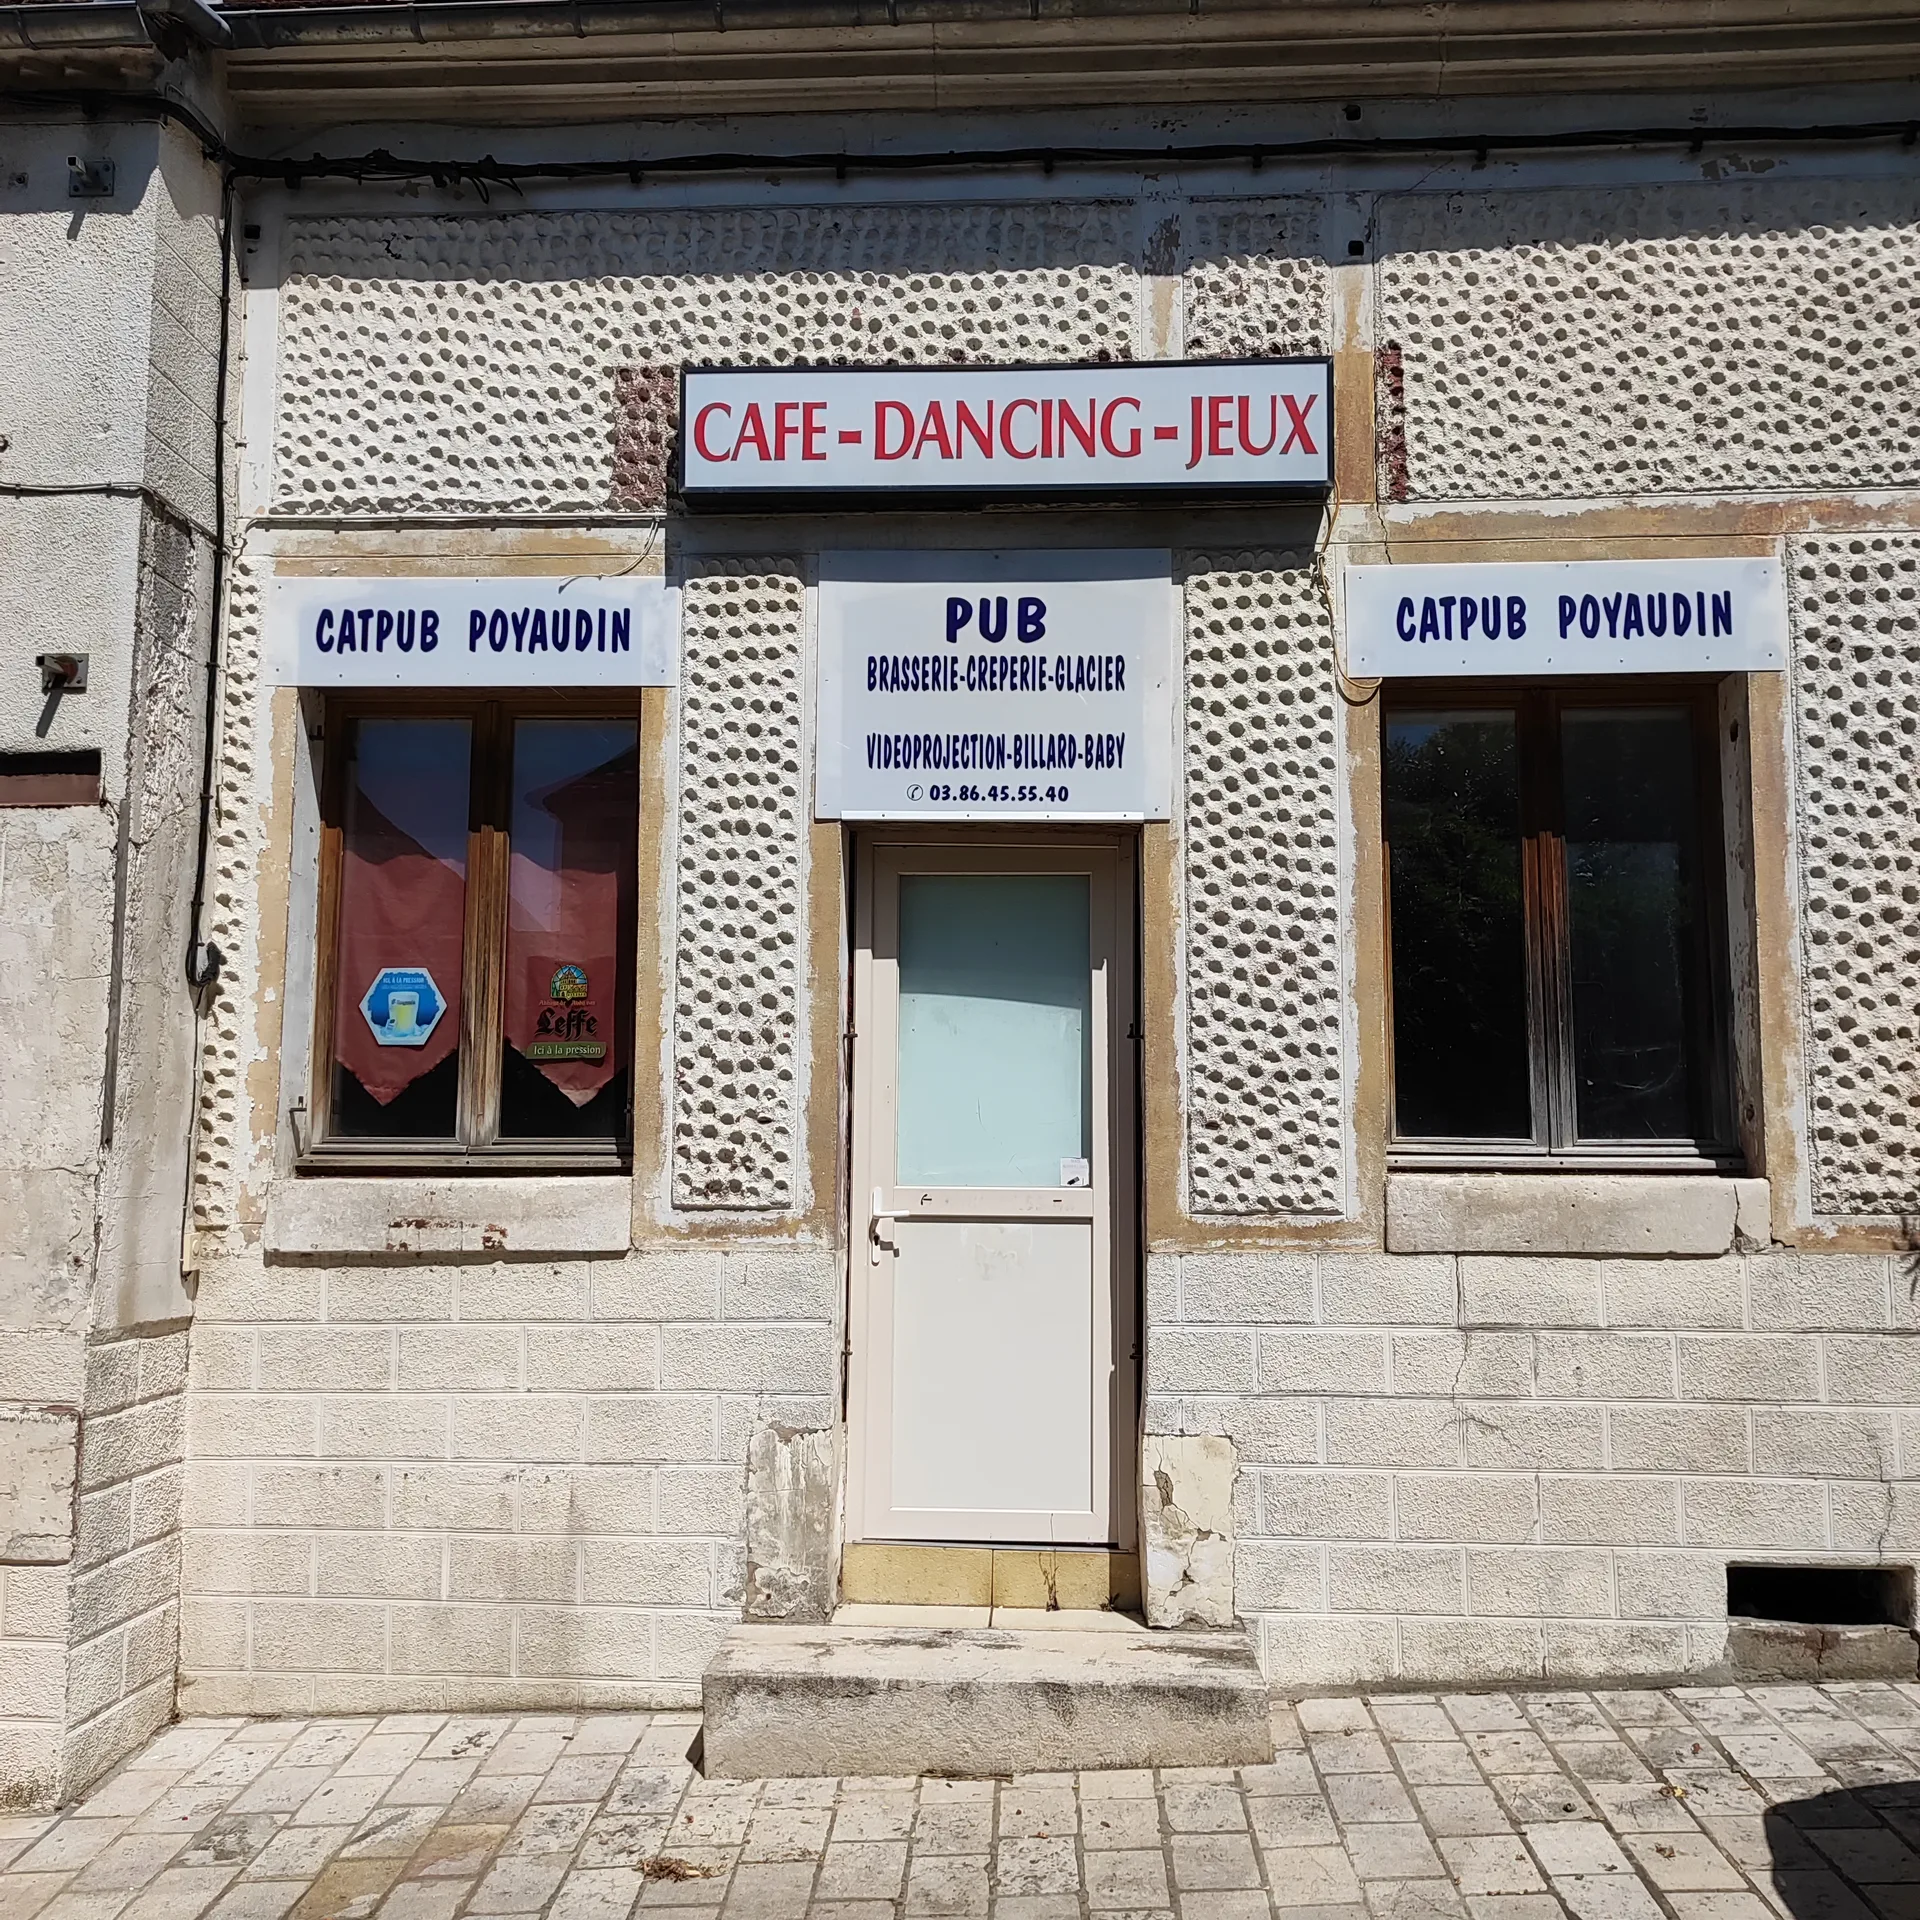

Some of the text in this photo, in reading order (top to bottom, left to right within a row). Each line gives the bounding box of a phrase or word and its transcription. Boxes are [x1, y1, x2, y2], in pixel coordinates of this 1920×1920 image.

[315, 606, 632, 655] CATPUB POYAUDIN
[945, 595, 1048, 645] PUB
[1396, 590, 1734, 644] CATPUB POYAUDIN
[928, 784, 1070, 803] 03.86.45.55.40
[534, 1007, 598, 1040] Leffe
[534, 1045, 545, 1055] Ici
[555, 1045, 563, 1054] la
[565, 1045, 601, 1056] pression
